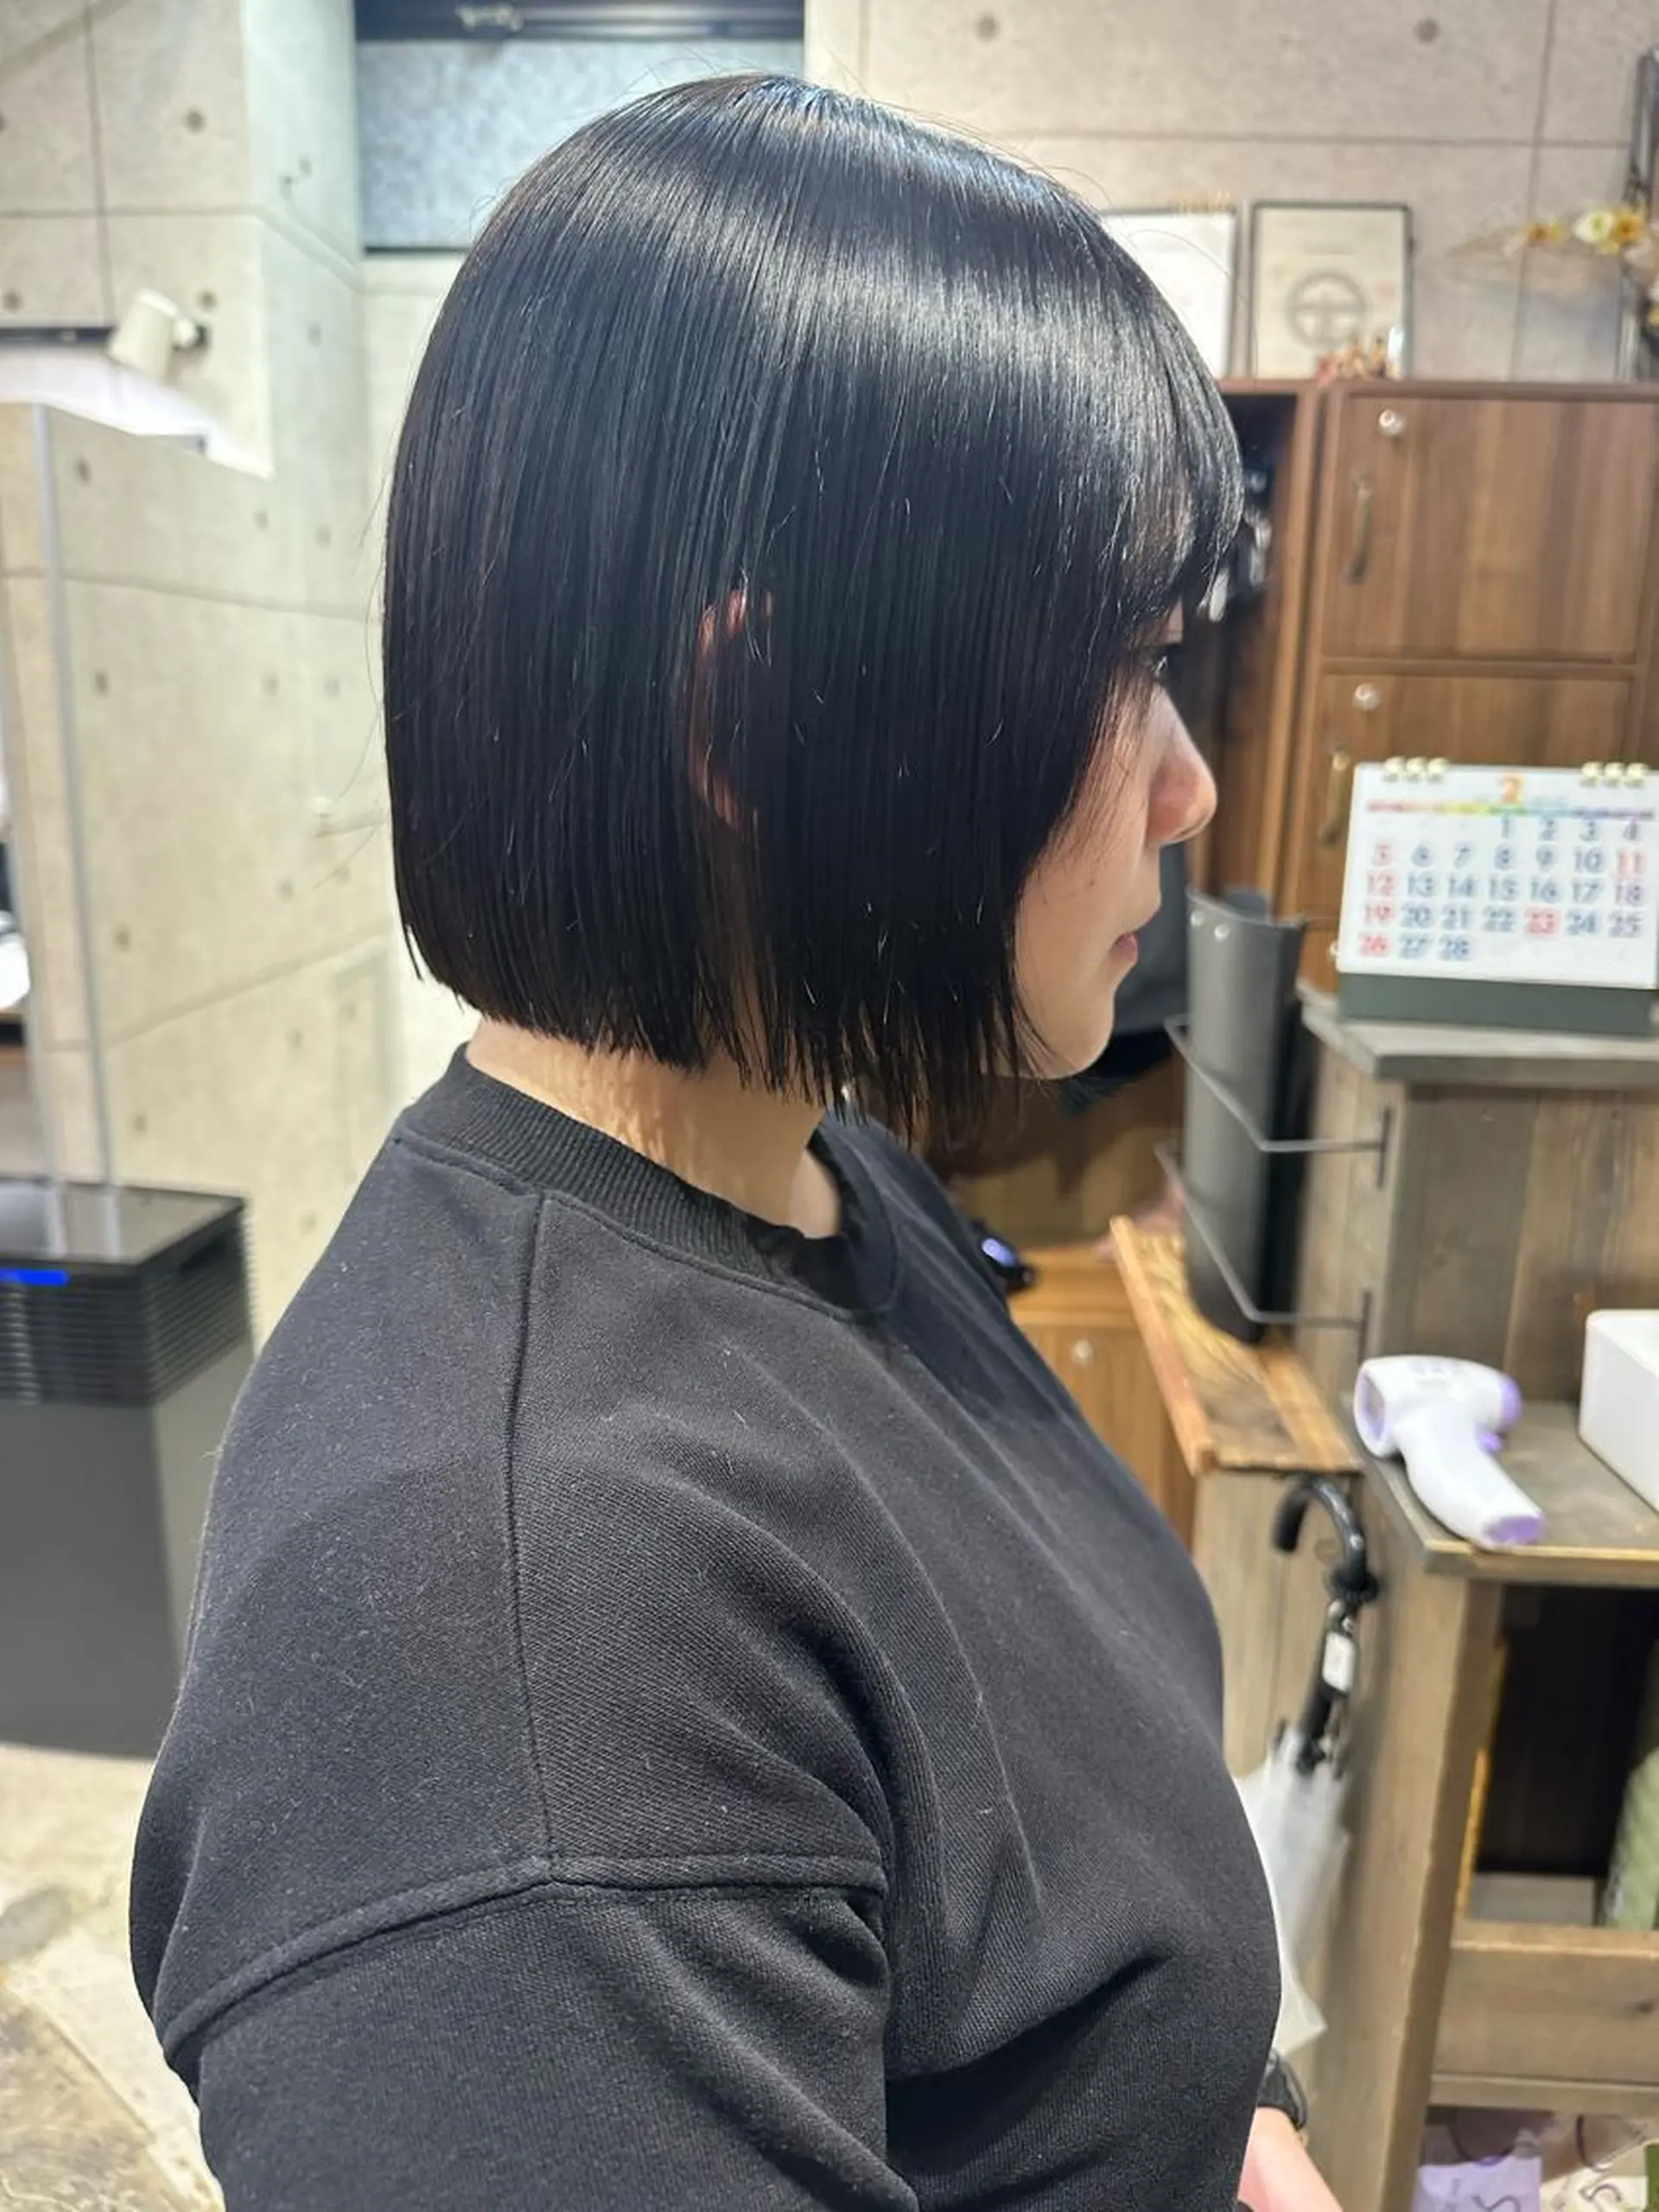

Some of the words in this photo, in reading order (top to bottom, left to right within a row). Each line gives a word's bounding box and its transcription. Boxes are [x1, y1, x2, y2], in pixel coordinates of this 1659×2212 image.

[1502, 817, 1512, 838] 1
[1539, 817, 1556, 841] 2
[1580, 818, 1599, 841] 3
[1623, 818, 1640, 841] 4
[1372, 842, 1391, 866] 5
[1411, 842, 1433, 868] 6
[1453, 842, 1474, 868] 7
[1494, 844, 1514, 870] 8
[1536, 845, 1555, 872] 9
[1573, 846, 1604, 874] 10
[1618, 849, 1645, 875] 11
[1367, 871, 1397, 895] 12
[1407, 872, 1434, 897] 13
[1448, 874, 1475, 898] 14
[1489, 874, 1518, 900] 15
[1530, 876, 1559, 903] 16
[1573, 878, 1603, 904] 17
[1614, 880, 1644, 906] 18
[1364, 902, 1393, 925] 19
[1400, 902, 1431, 928] 20
[1441, 904, 1471, 930] 21
[1483, 906, 1516, 932] 22
[1525, 907, 1558, 936] 23
[1565, 908, 1598, 934] 24
[1608, 911, 1643, 938] 25
[1358, 934, 1389, 957] 26
[1399, 934, 1432, 959] 27
[1440, 935, 1470, 961] 28
